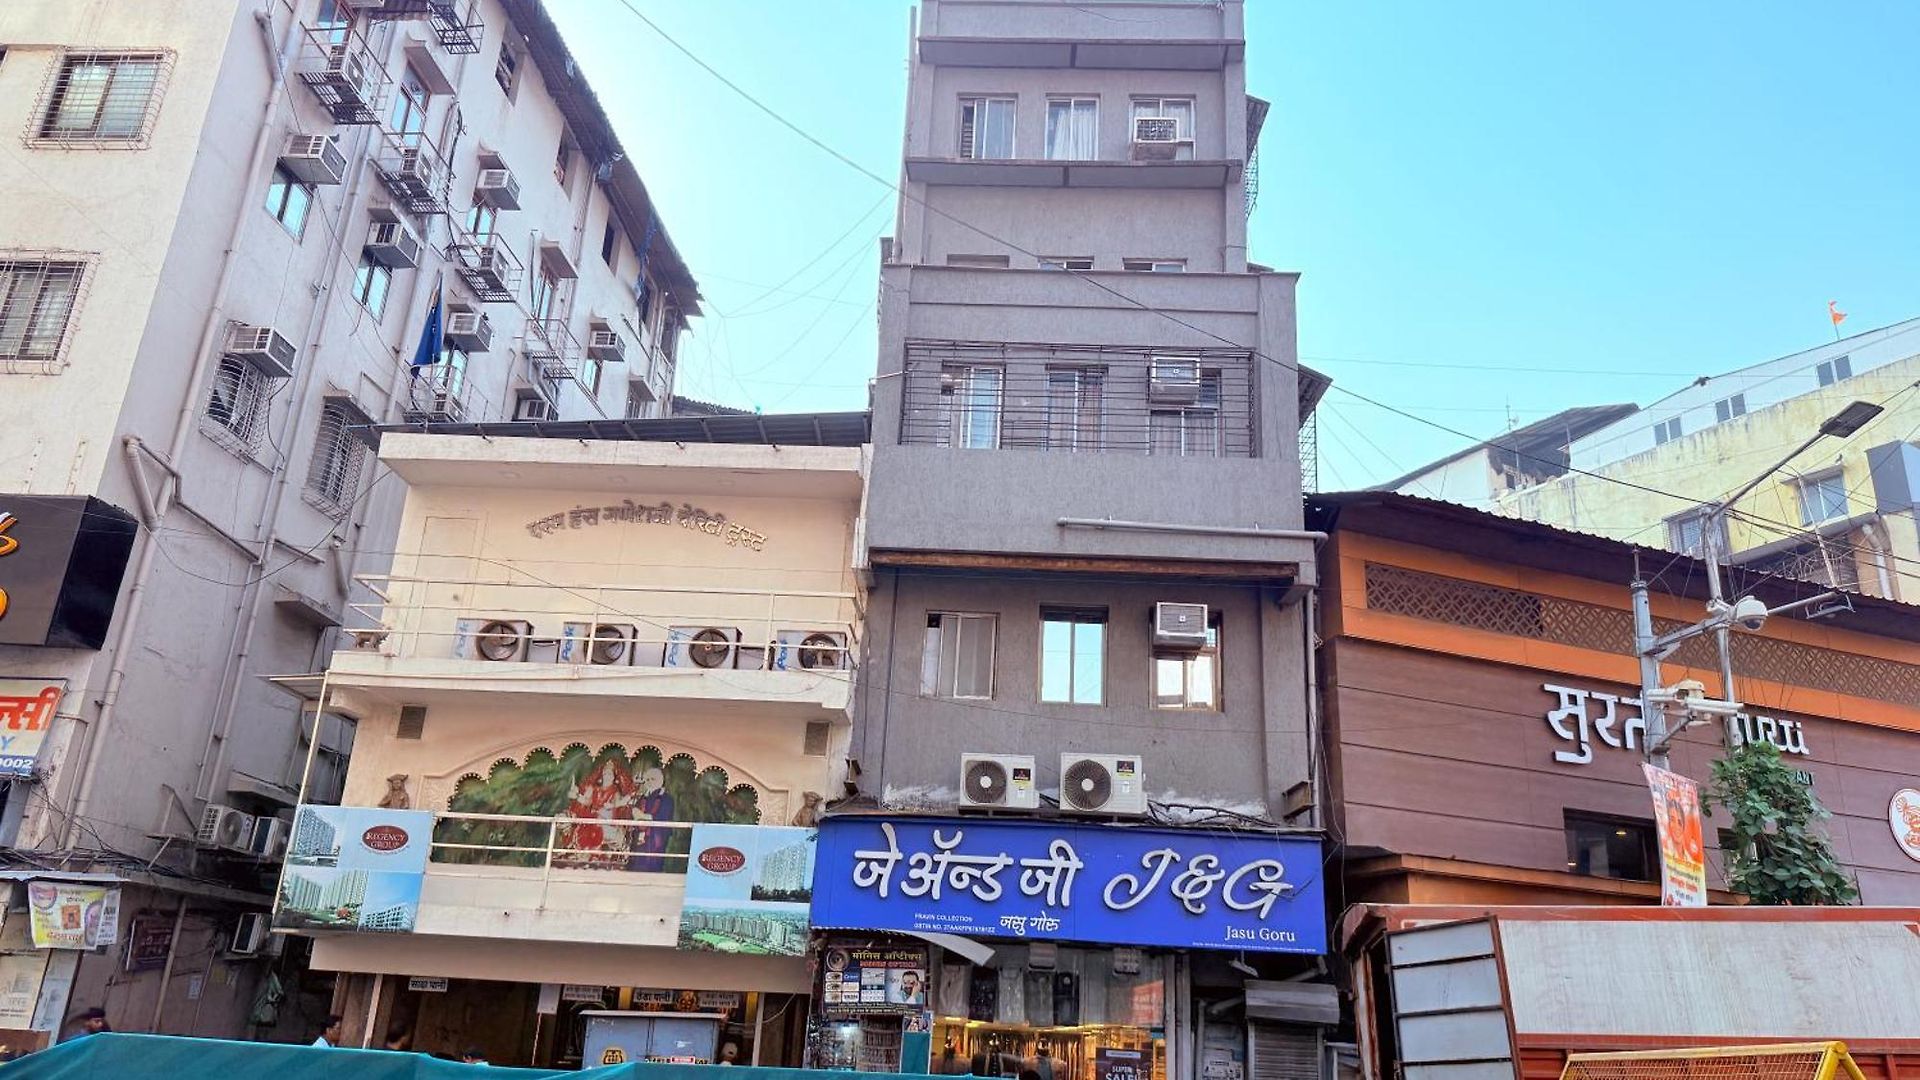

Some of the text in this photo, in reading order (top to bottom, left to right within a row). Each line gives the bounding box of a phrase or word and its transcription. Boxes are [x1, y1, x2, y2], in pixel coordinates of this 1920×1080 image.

[365, 832, 405, 841] REGENCY
[370, 840, 401, 848] GROUP
[702, 854, 742, 863] REGENCY
[707, 862, 737, 870] GROUP
[853, 822, 903, 898] जे
[1020, 839, 1084, 907] जी
[936, 914, 973, 923] COLLECTION
[1224, 925, 1296, 942] Jasu Goru
